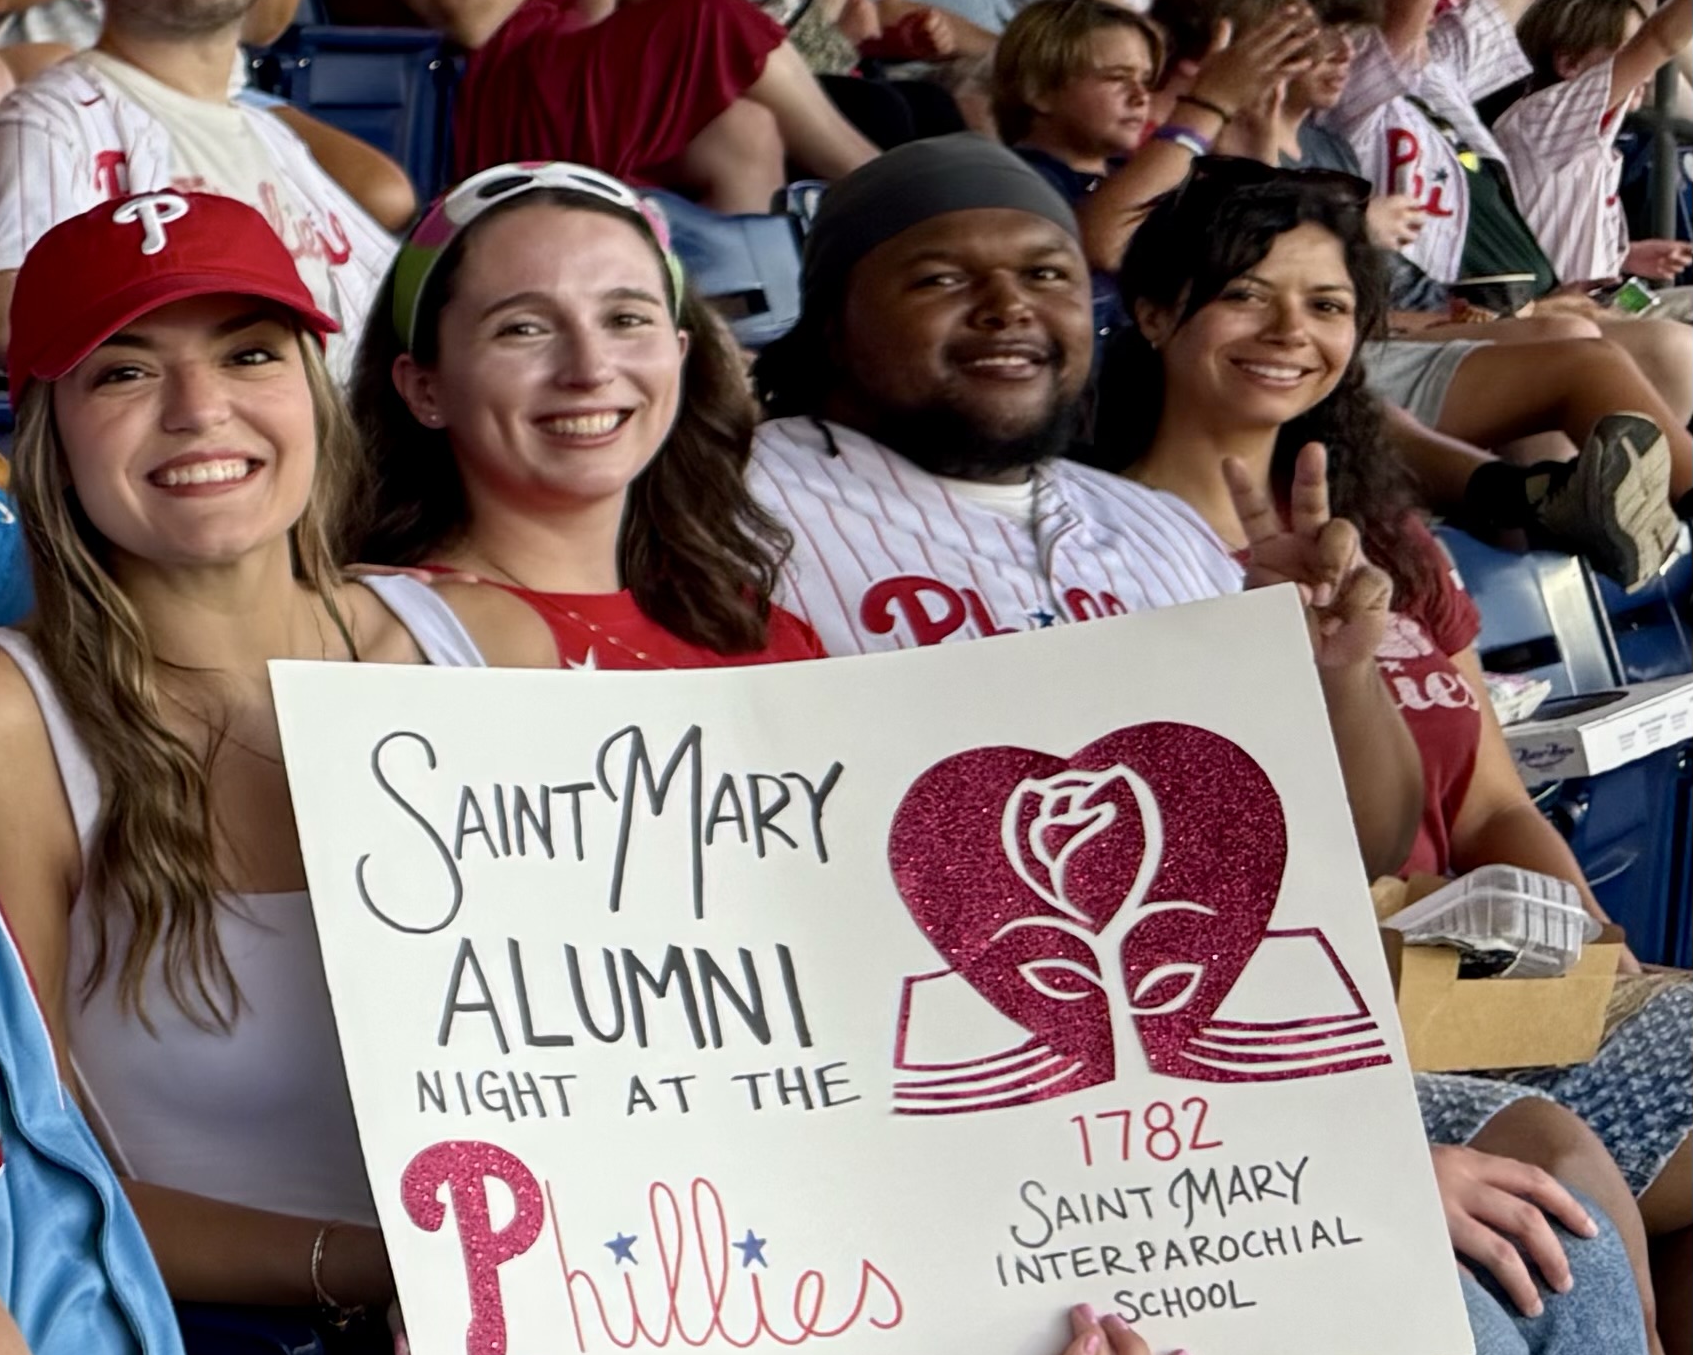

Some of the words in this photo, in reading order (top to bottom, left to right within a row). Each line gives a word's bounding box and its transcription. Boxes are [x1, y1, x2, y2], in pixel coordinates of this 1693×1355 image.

[112, 194, 190, 256] P
[437, 936, 814, 1055] ALUMNI
[416, 1069, 578, 1123] NIGHT
[627, 1073, 697, 1117] AT
[730, 1060, 862, 1112] THE
[1069, 1095, 1224, 1167] 1782
[995, 1215, 1364, 1287] INTERPAROCHIAL
[1113, 1279, 1257, 1324] SCHOOL
